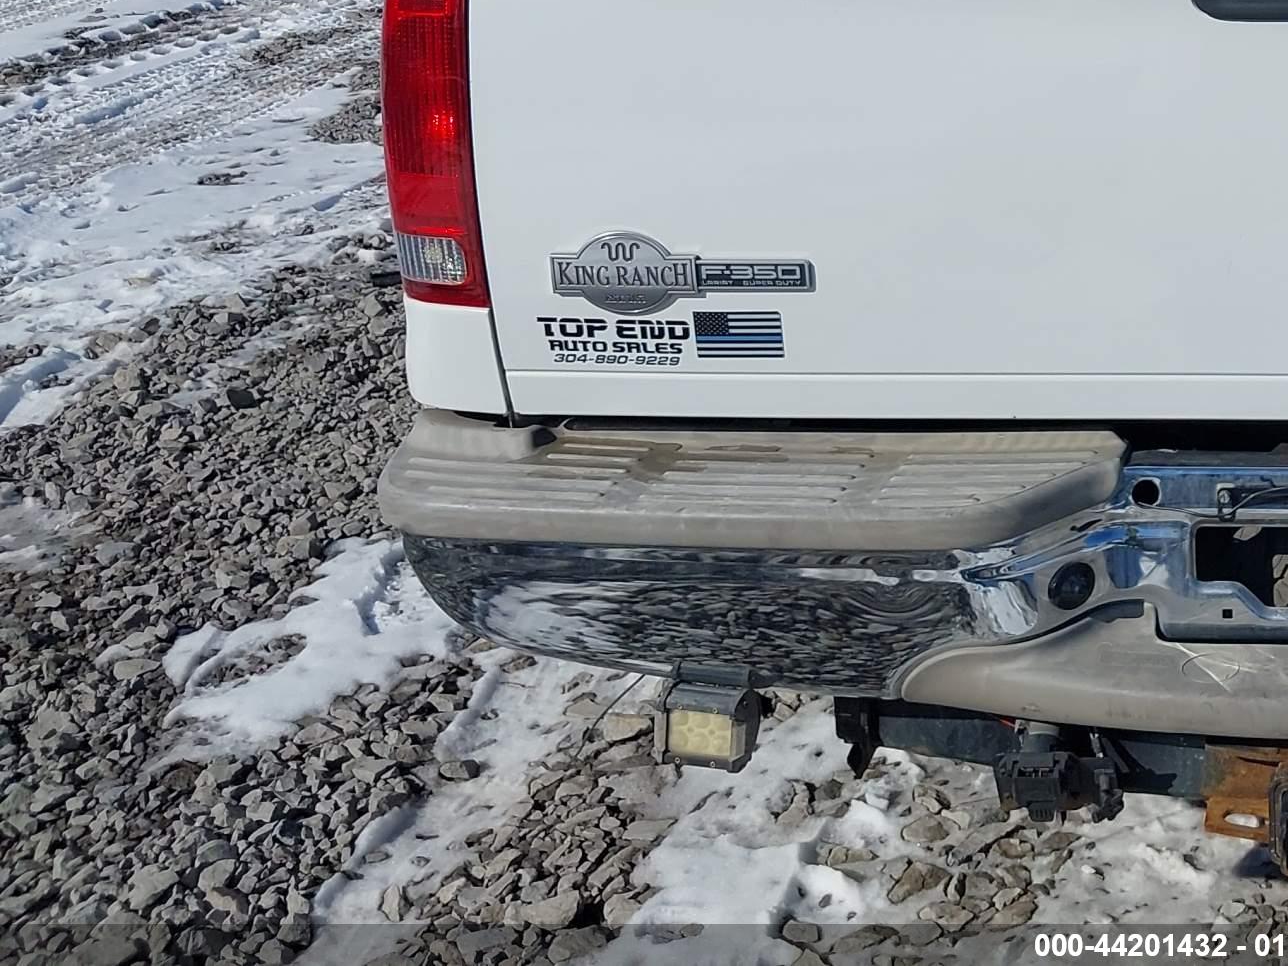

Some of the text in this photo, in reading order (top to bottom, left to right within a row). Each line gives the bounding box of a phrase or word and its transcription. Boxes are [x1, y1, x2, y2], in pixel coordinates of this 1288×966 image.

[557, 261, 690, 287] KING RANCH
[701, 265, 801, 280] F-350
[536, 316, 690, 340] TOP END
[548, 339, 683, 354] AUTO SALES
[553, 353, 681, 366] 304-890-9229
